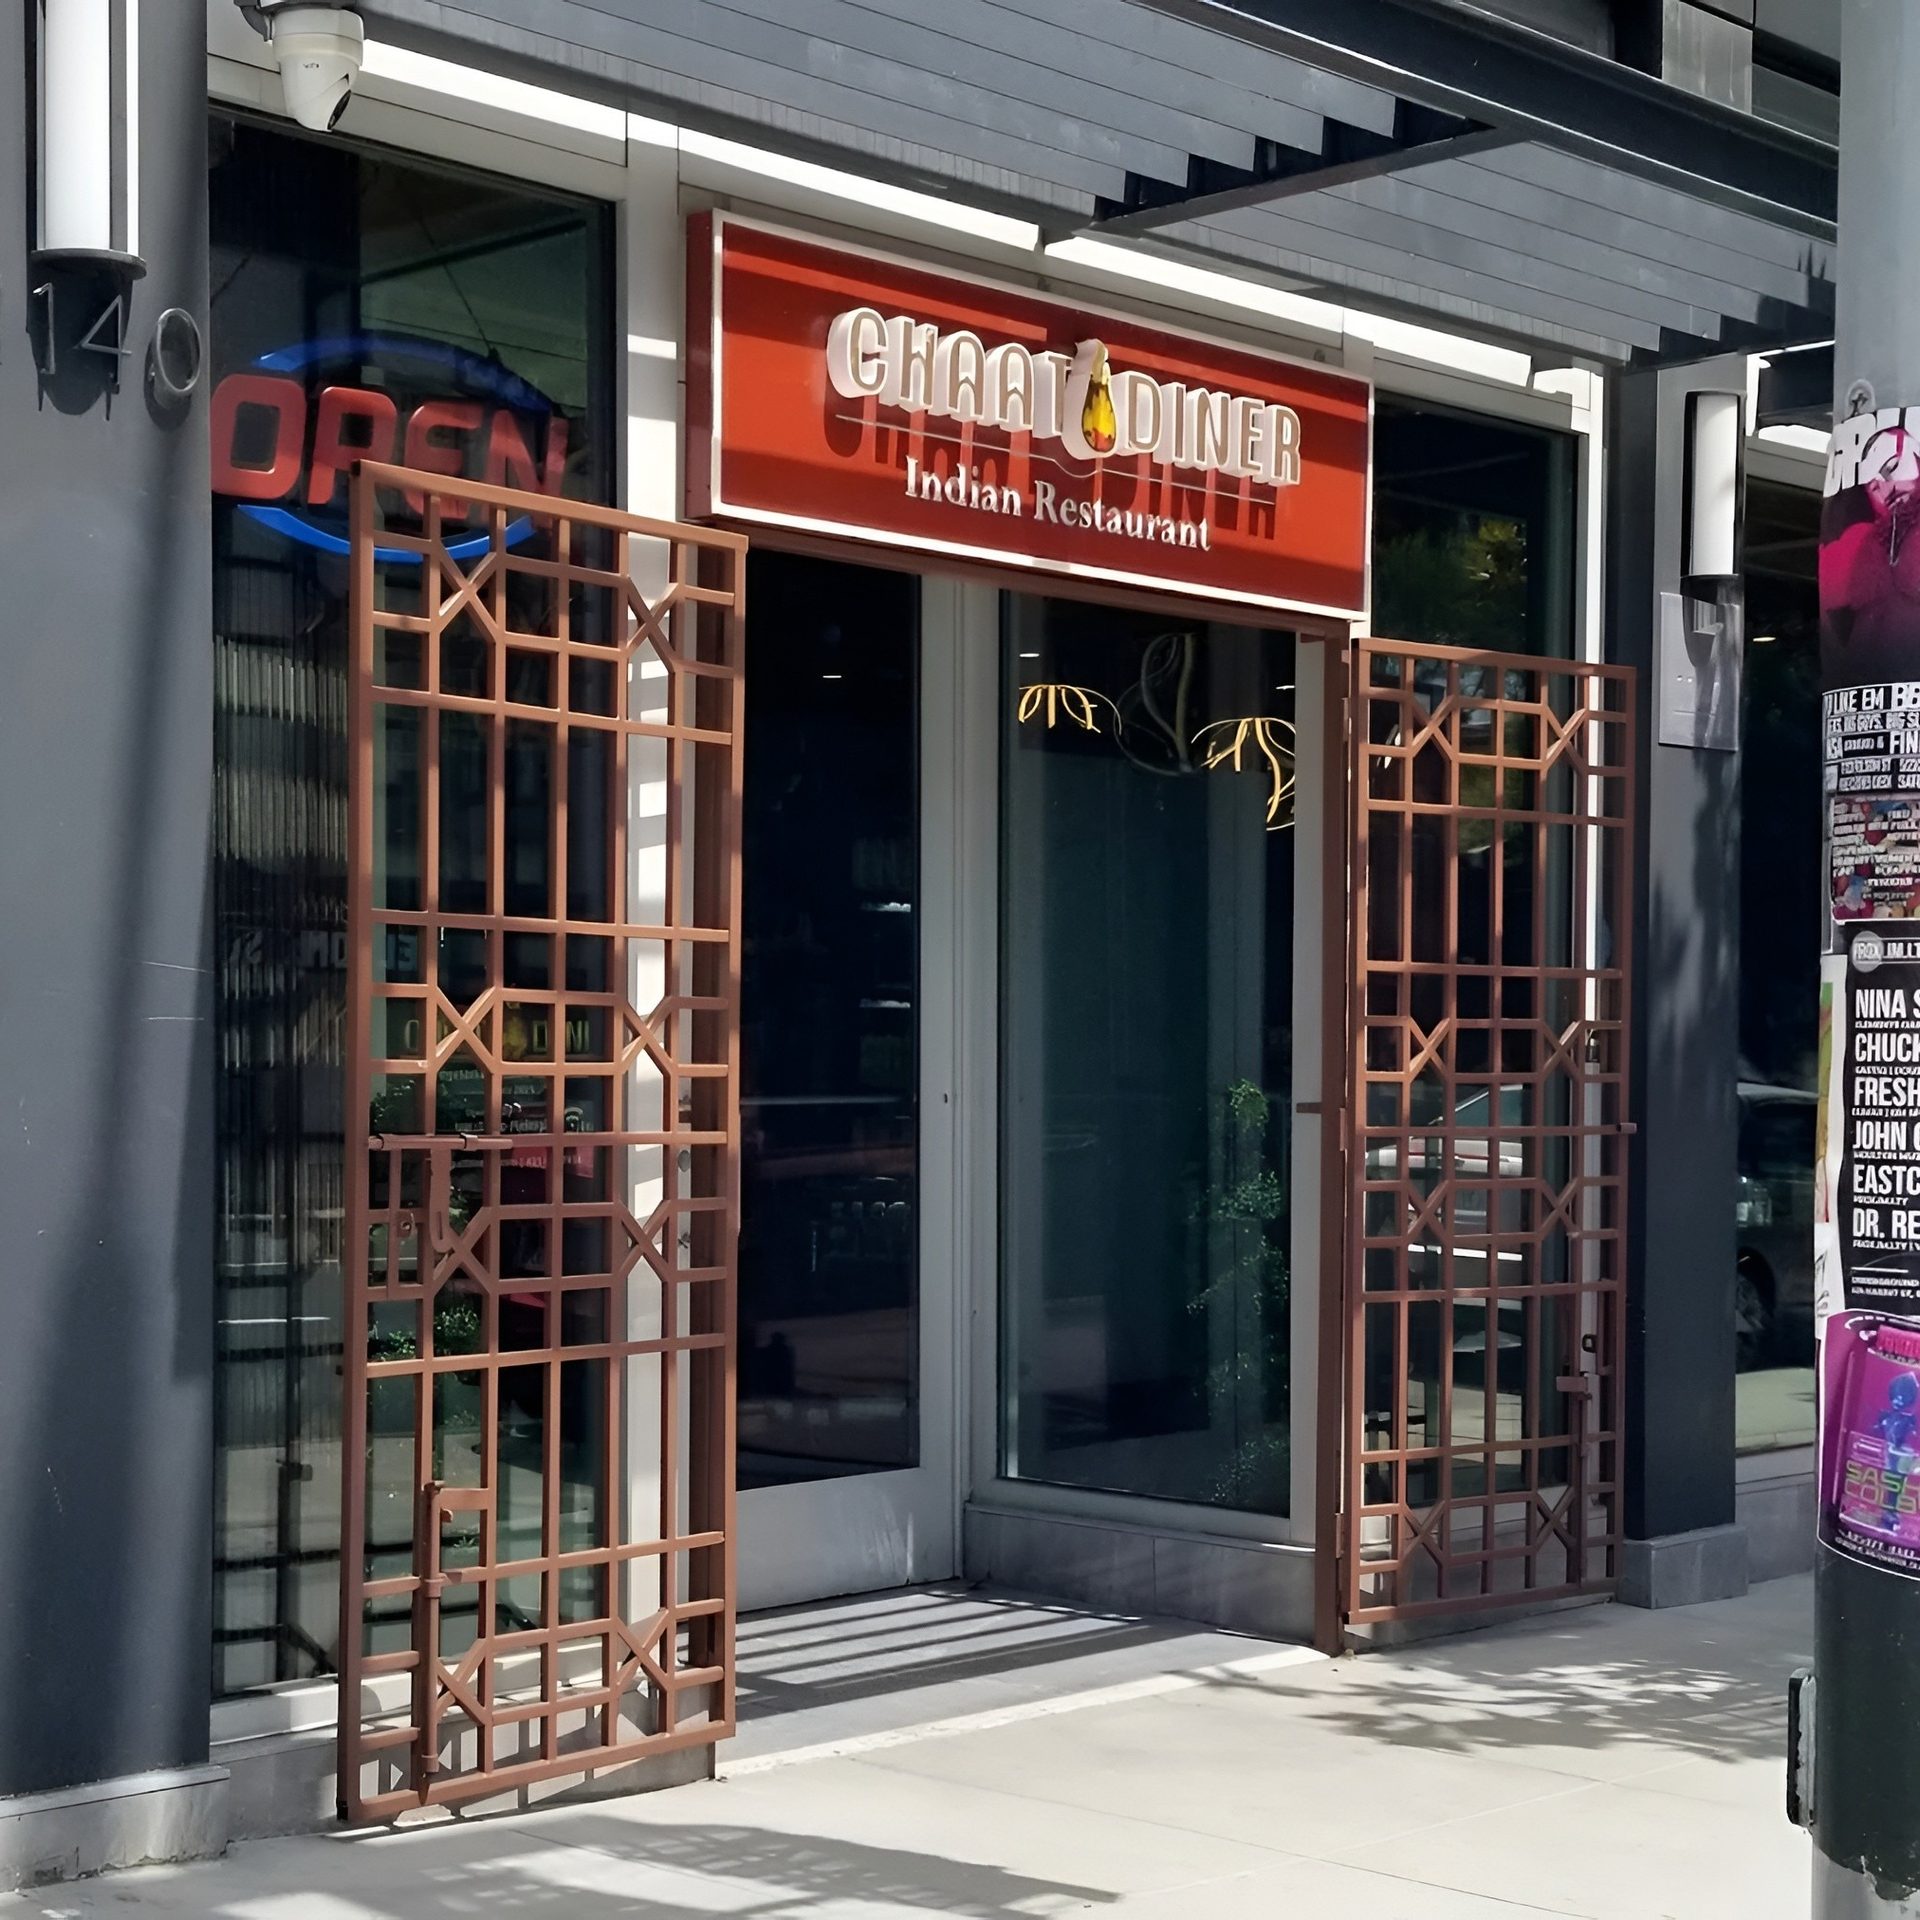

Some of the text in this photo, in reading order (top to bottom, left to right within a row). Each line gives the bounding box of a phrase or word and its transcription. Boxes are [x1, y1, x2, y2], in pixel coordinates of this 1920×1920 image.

[33, 282, 201, 394] 140
[828, 306, 1300, 487] CHAAT DINER
[211, 372, 569, 531] OPEN
[905, 455, 1212, 552] Indian Restaurant
[1855, 988, 1907, 1019] NINA
[1852, 1120, 1907, 1151] JOHN
[1852, 1207, 1886, 1239] DR.
